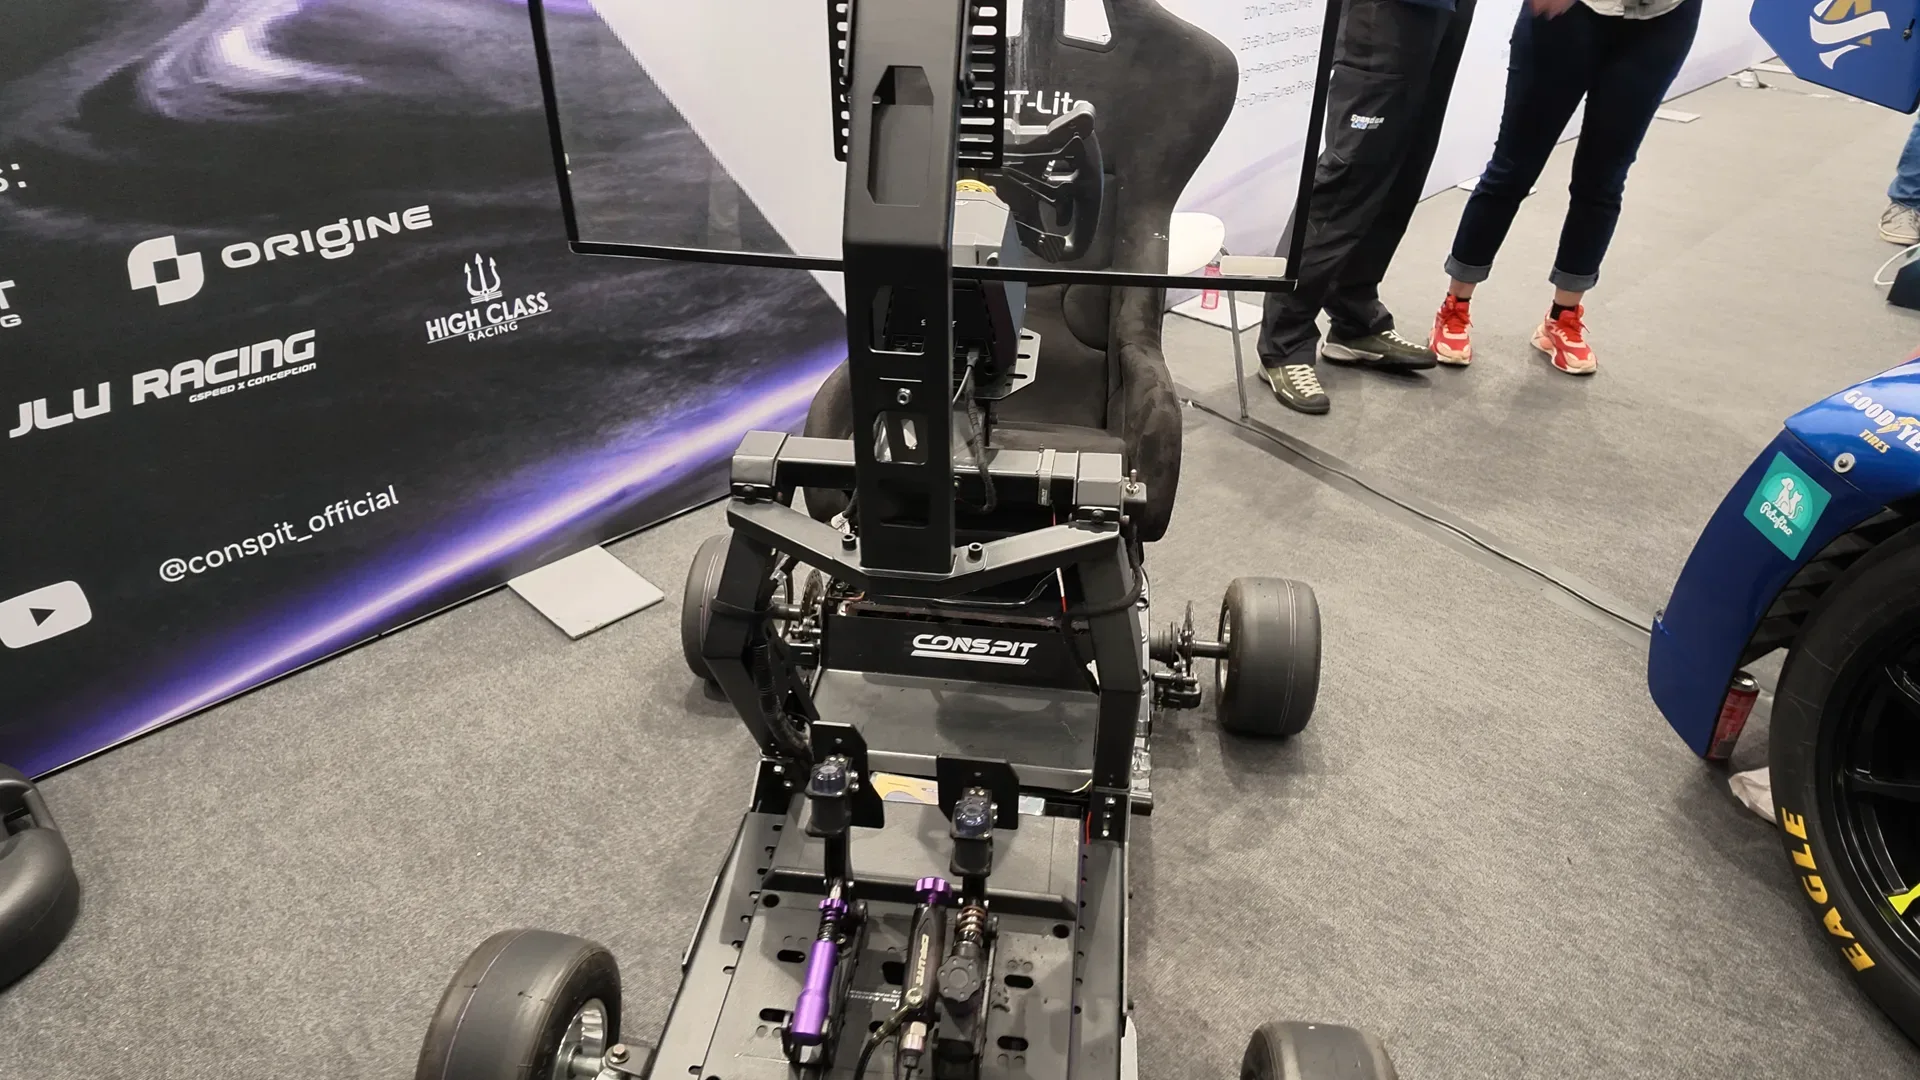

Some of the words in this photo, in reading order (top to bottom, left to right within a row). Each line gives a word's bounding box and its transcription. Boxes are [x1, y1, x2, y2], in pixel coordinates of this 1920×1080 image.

[426, 308, 481, 341] HIGH
[486, 291, 549, 324] CLASS
[468, 321, 518, 342] RACING
[9, 381, 111, 438] JLU
[1859, 429, 1891, 454] TIRES
[159, 484, 399, 582] @conspit_official
[912, 634, 1038, 657] CONSPIT
[1781, 806, 1876, 972] EAGLE
